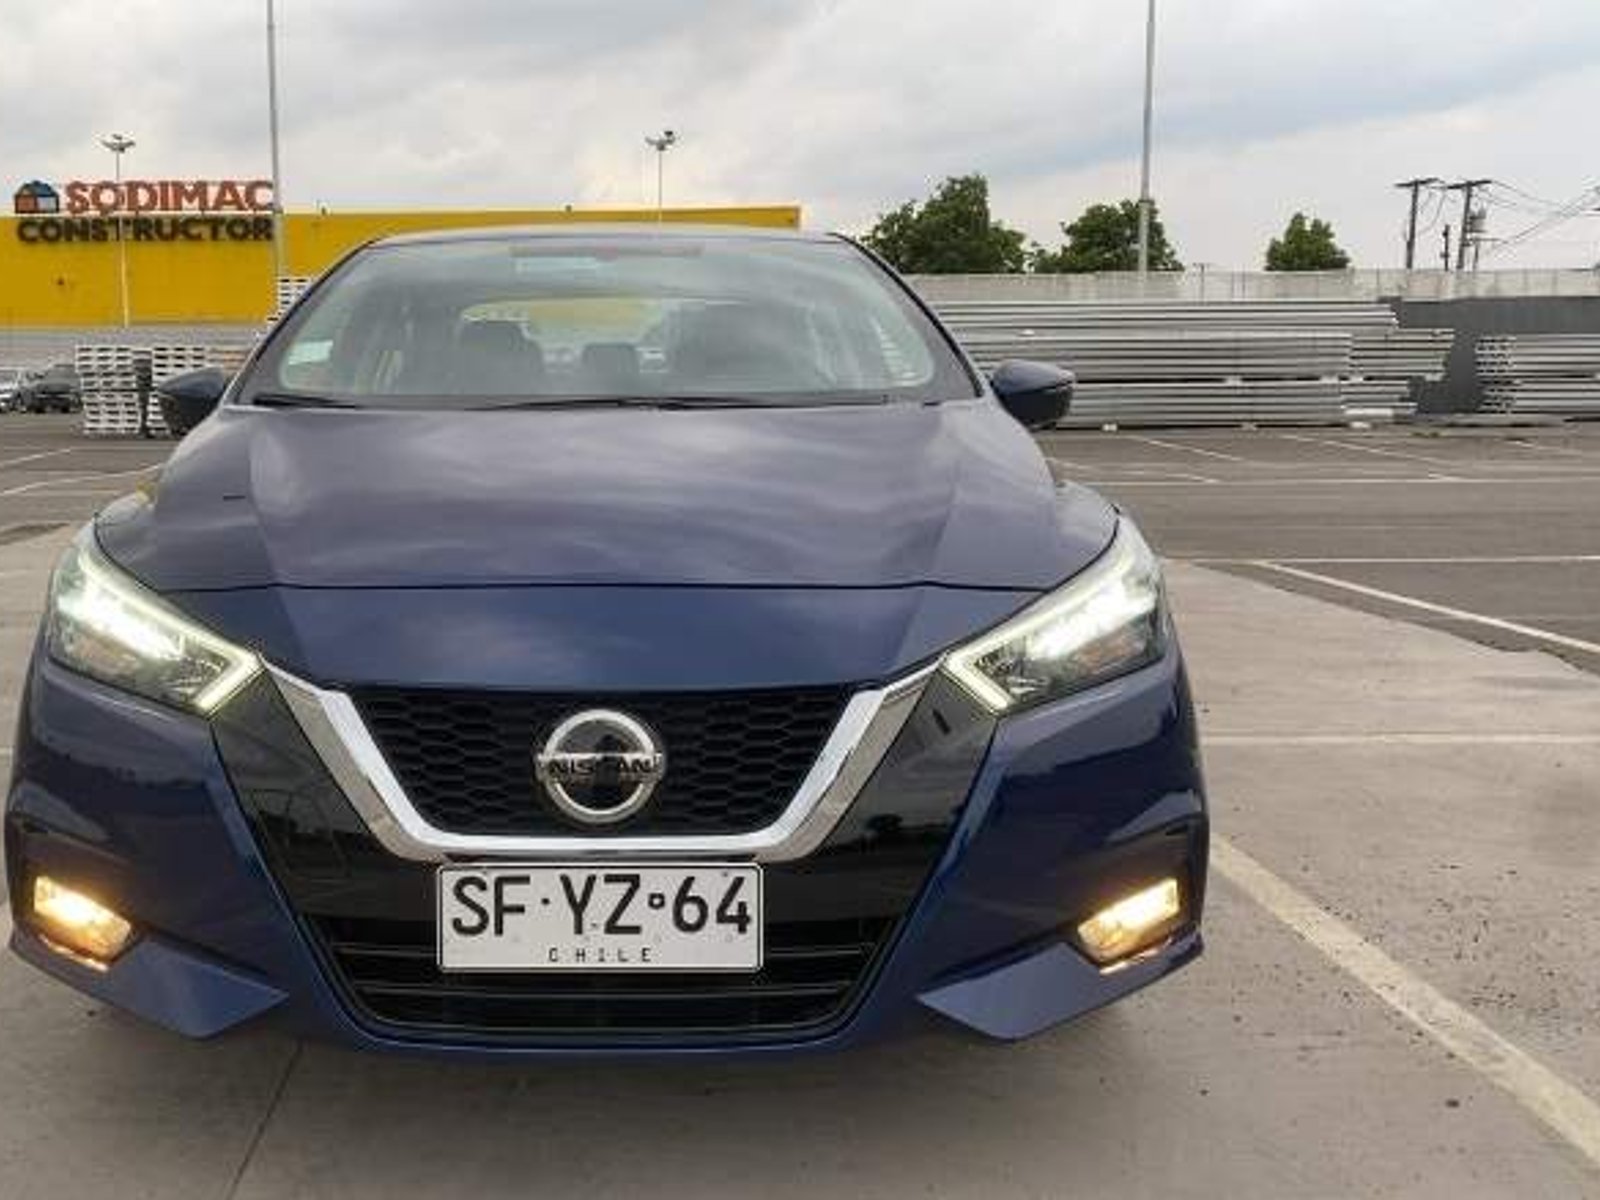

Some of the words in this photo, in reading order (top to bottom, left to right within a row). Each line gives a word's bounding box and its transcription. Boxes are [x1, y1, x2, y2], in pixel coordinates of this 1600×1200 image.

[66, 180, 273, 213] SODIMAC
[17, 217, 273, 242] CONSTRUCTOR
[549, 948, 652, 962] CHILE
